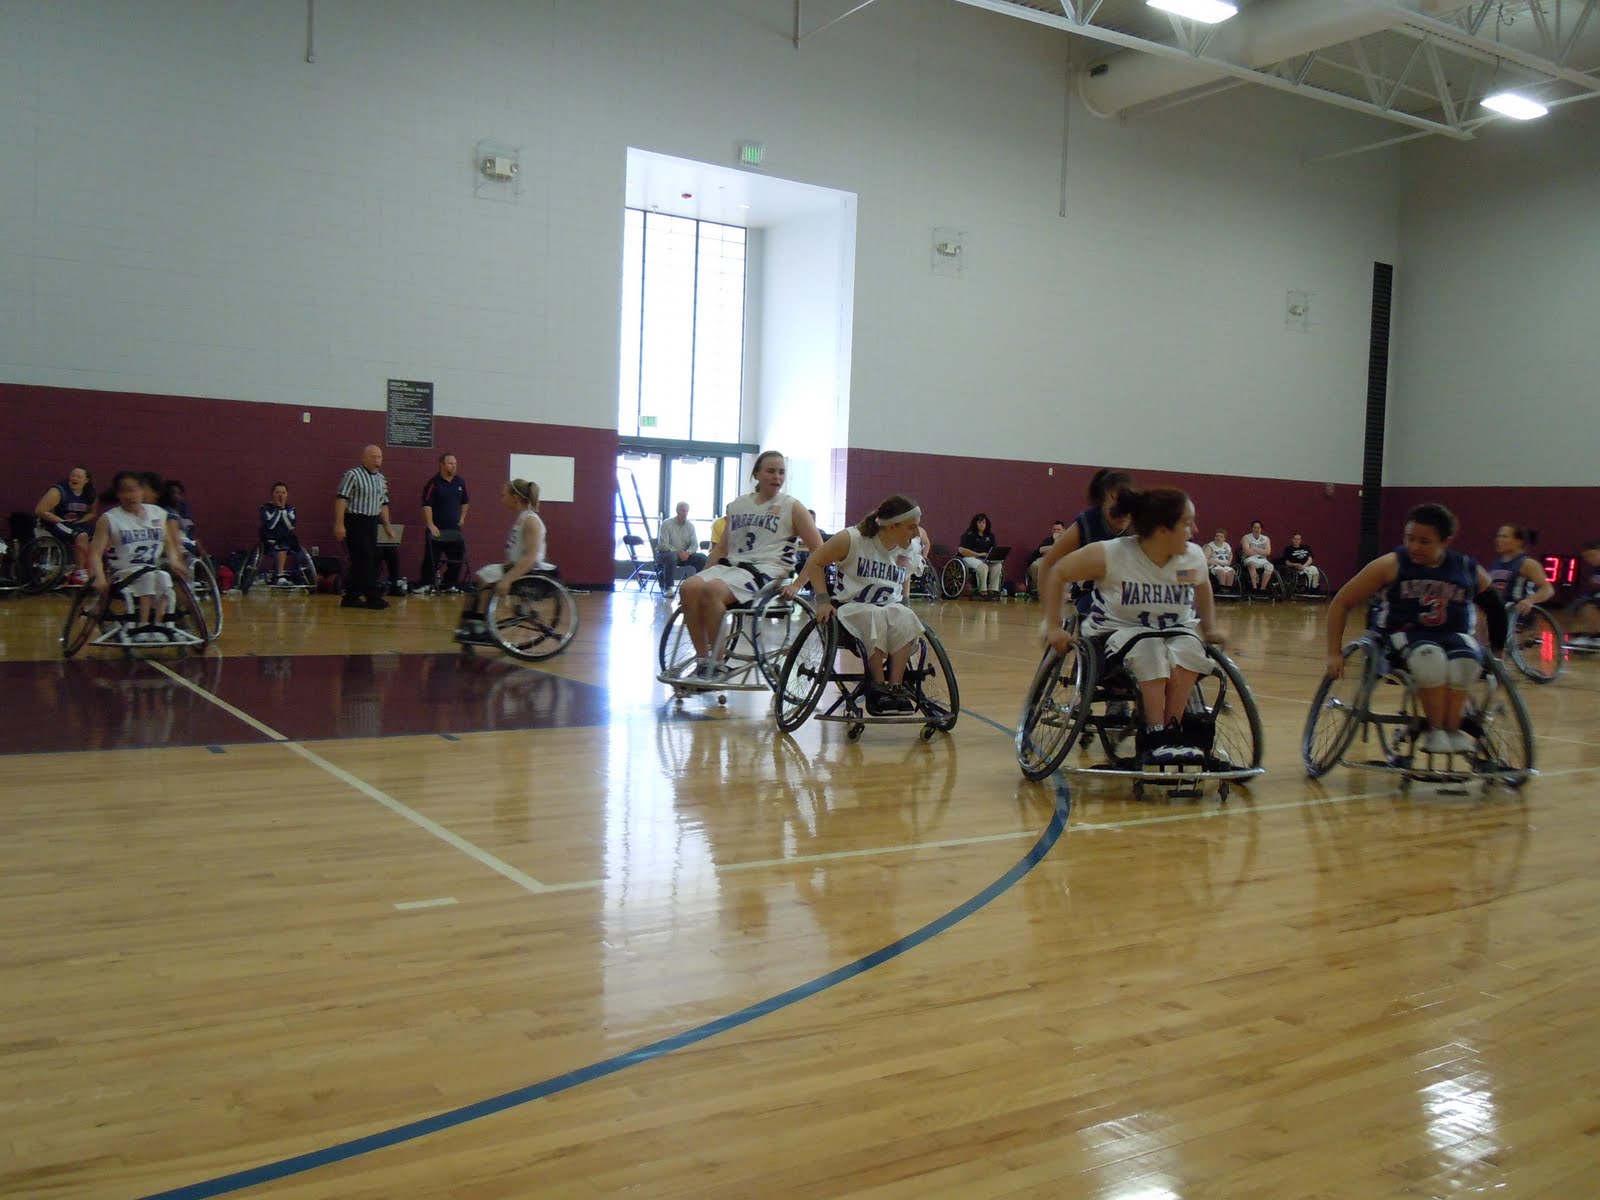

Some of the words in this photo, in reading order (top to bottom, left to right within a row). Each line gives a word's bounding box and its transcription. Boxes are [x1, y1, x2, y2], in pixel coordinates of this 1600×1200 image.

[731, 513, 781, 533] WARHAWKS
[119, 528, 162, 545] WARHAW
[738, 532, 756, 553] 3
[130, 544, 159, 564] 21
[1543, 557, 1577, 582] 31
[1418, 594, 1448, 626] 3
